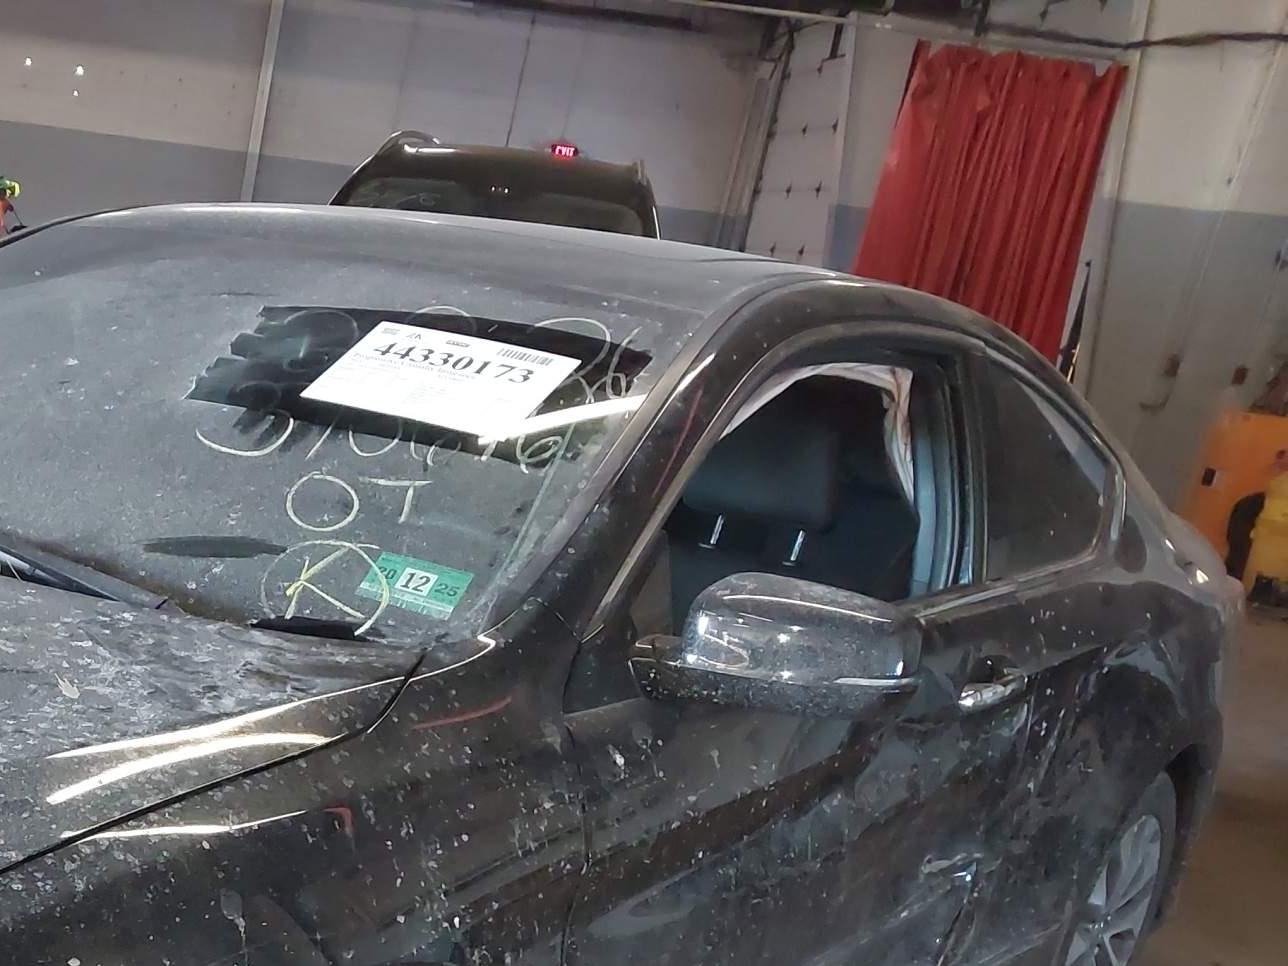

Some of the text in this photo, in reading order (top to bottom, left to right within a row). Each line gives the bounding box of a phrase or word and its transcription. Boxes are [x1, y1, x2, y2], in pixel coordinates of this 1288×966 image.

[372, 342, 535, 383] 44330173
[400, 572, 431, 593] 12
[434, 582, 461, 597] 25
